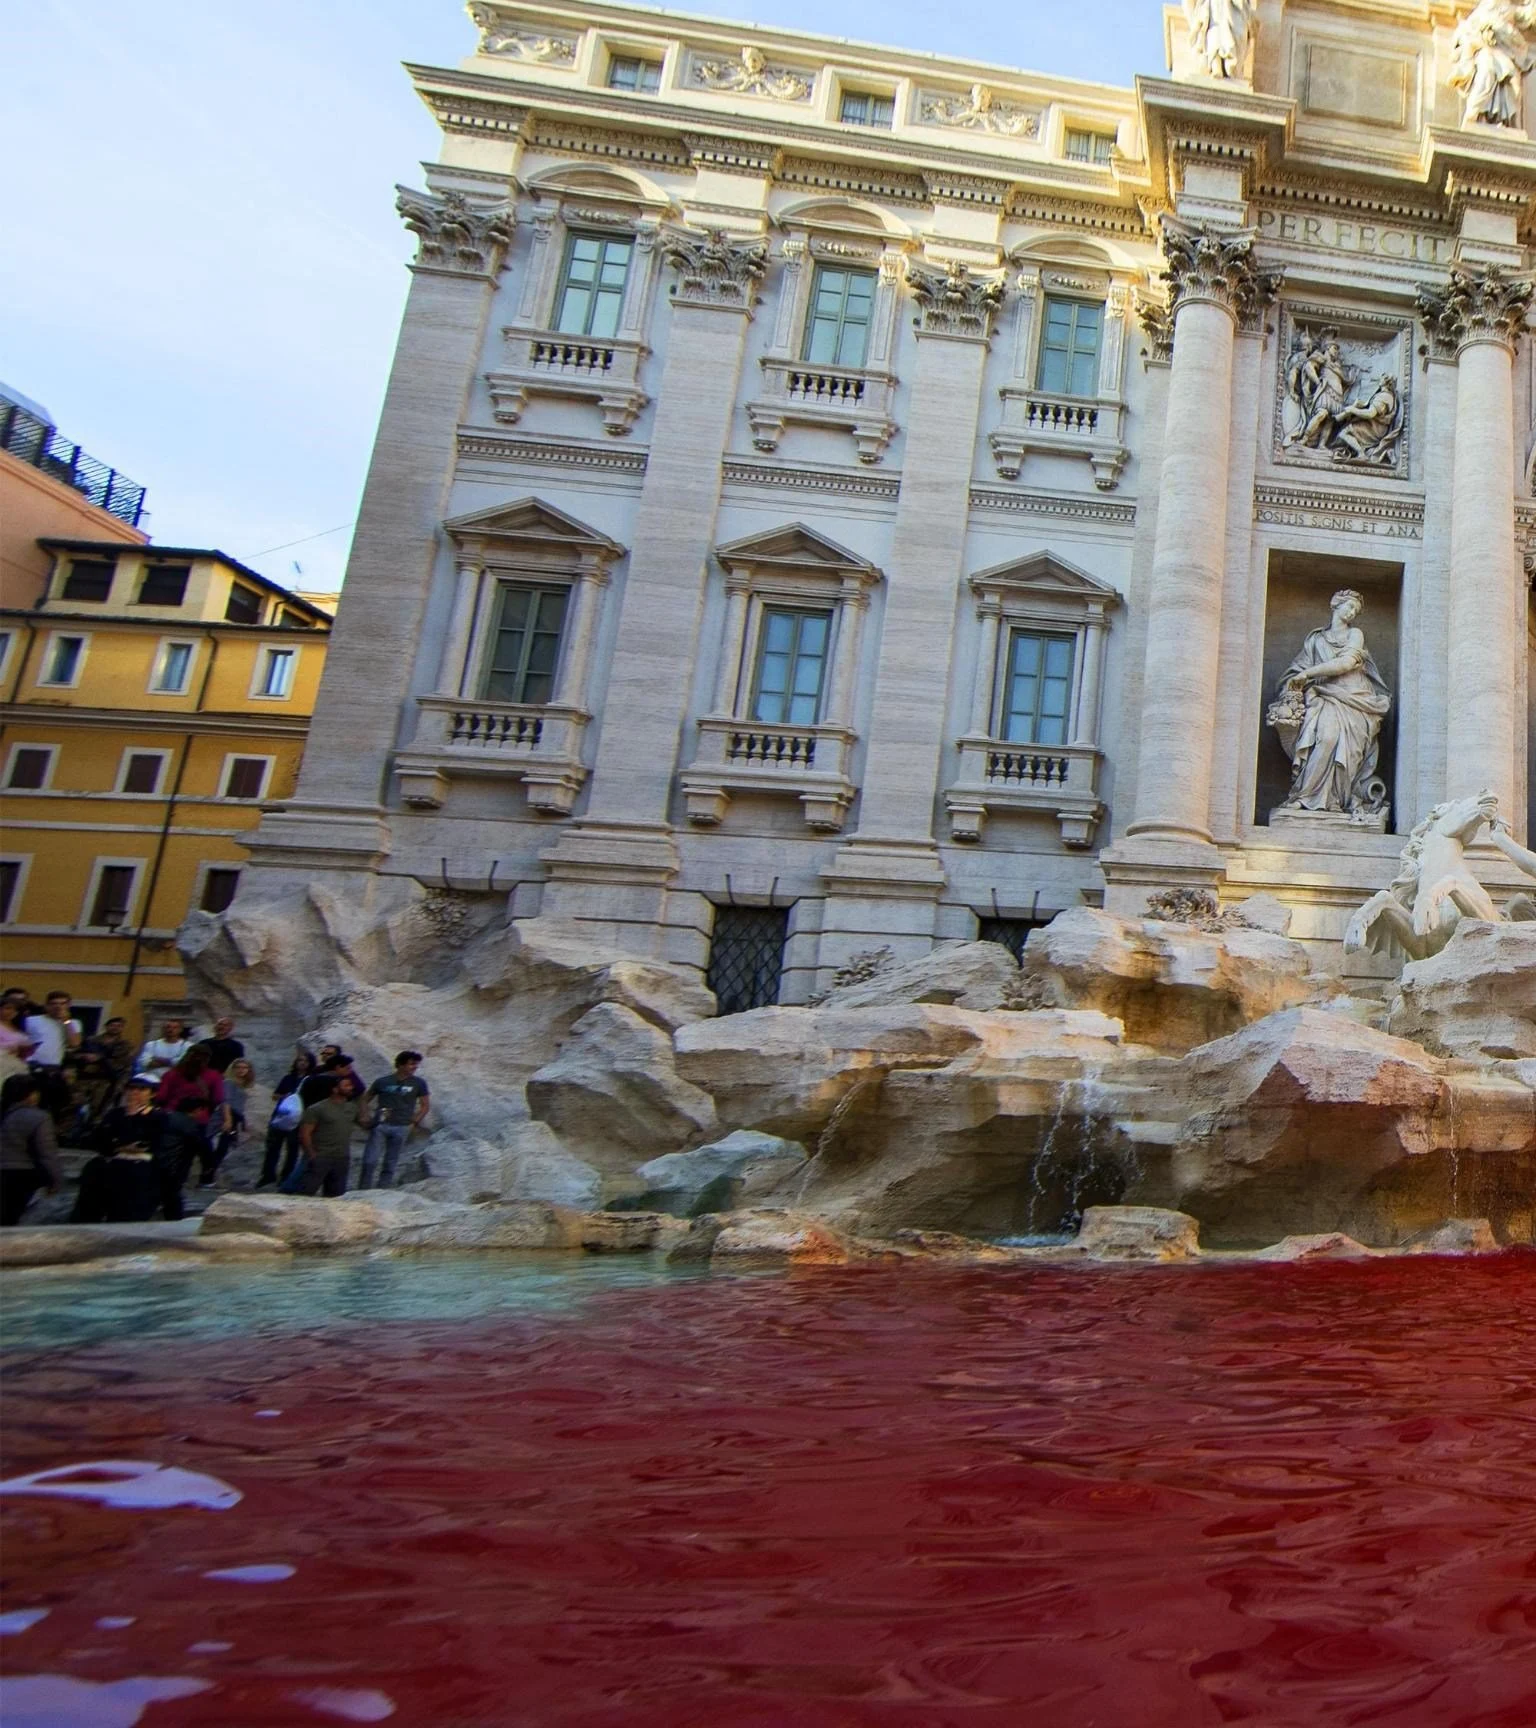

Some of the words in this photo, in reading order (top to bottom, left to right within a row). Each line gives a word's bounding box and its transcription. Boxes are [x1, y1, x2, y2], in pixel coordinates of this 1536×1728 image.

[1256, 210, 1448, 264] PERFECIT
[1256, 509, 1305, 525] POSITIS
[1362, 522, 1378, 534] ET
[1387, 525, 1419, 538] ANA
